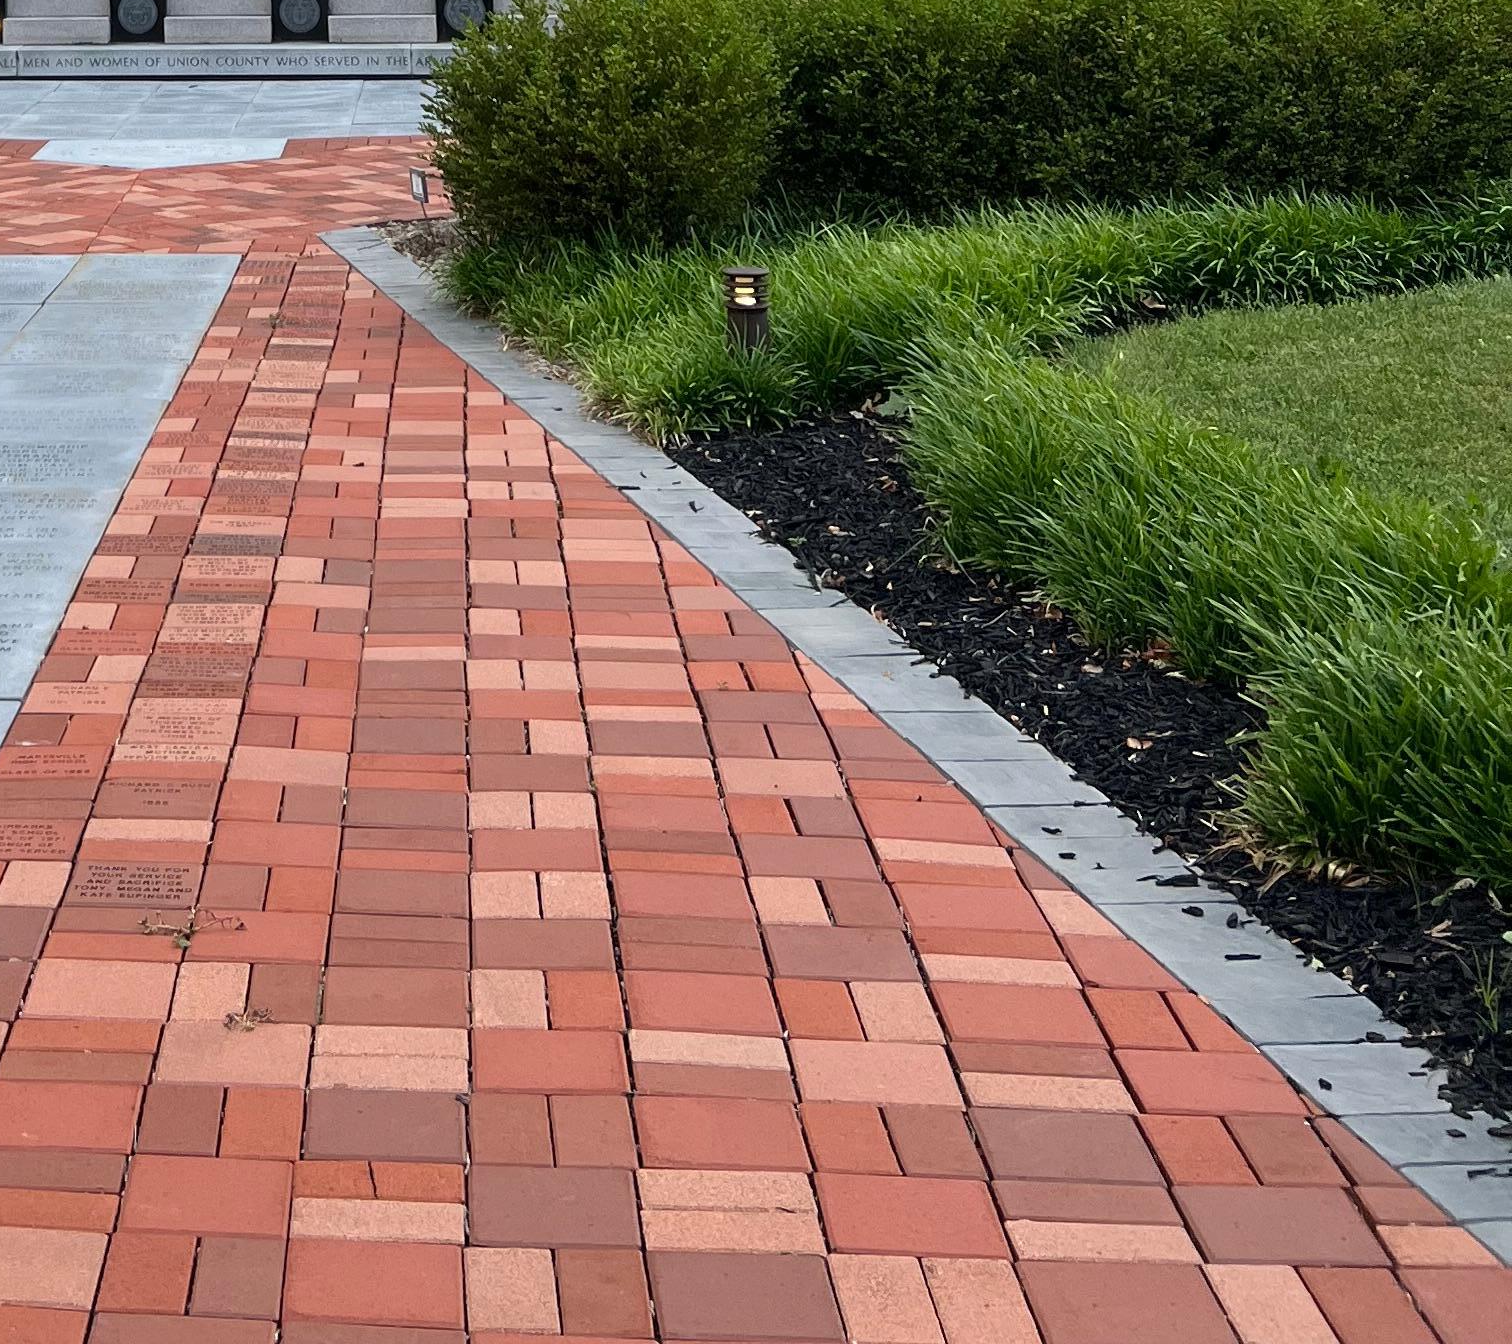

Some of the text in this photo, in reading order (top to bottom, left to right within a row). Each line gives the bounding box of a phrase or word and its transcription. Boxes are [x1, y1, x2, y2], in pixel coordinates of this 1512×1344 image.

[23, 57, 50, 68] MEN
[55, 57, 83, 67] AND
[89, 56, 138, 67] WOMEN
[145, 57, 161, 67] OF
[167, 56, 209, 66] UNION
[215, 56, 270, 66] COUNTY
[275, 56, 308, 66] WHO
[314, 56, 360, 66] SERVED
[366, 56, 379, 66] IN
[384, 55, 409, 66] THE
[88, 864, 128, 872] THANK
[91, 871, 123, 879] YOUR
